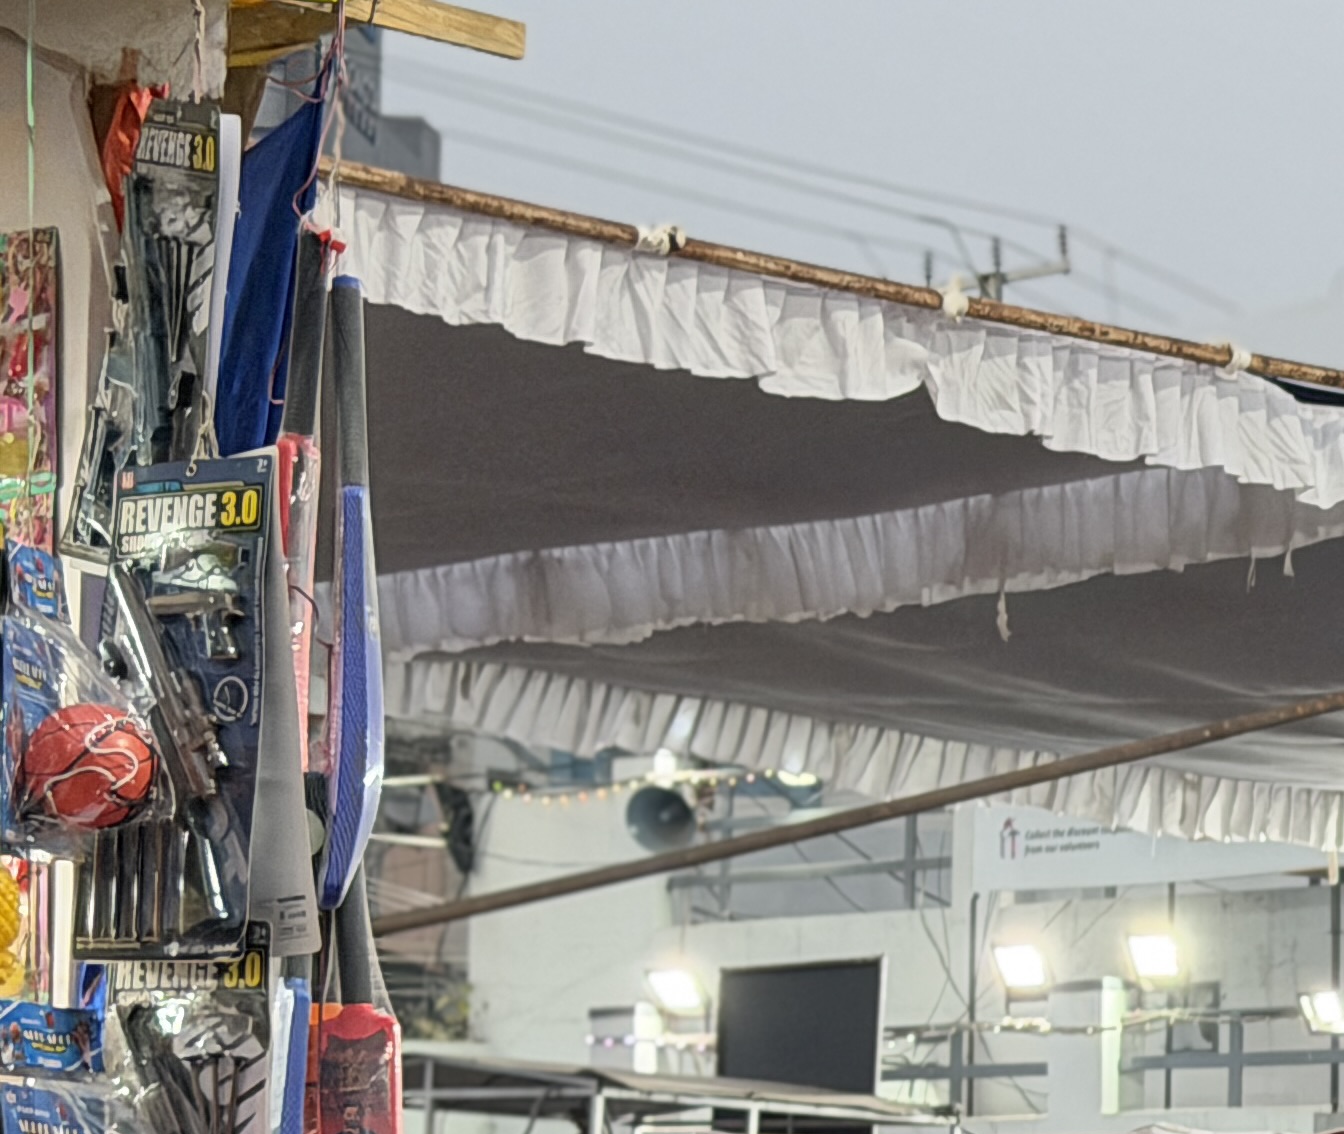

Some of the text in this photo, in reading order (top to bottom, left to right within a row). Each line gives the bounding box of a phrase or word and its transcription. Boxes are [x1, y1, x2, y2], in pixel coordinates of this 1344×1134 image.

[137, 127, 214, 172] REVENGE 3.0
[120, 490, 258, 534] REVENGE 3.0
[224, 951, 261, 988] 3.0
